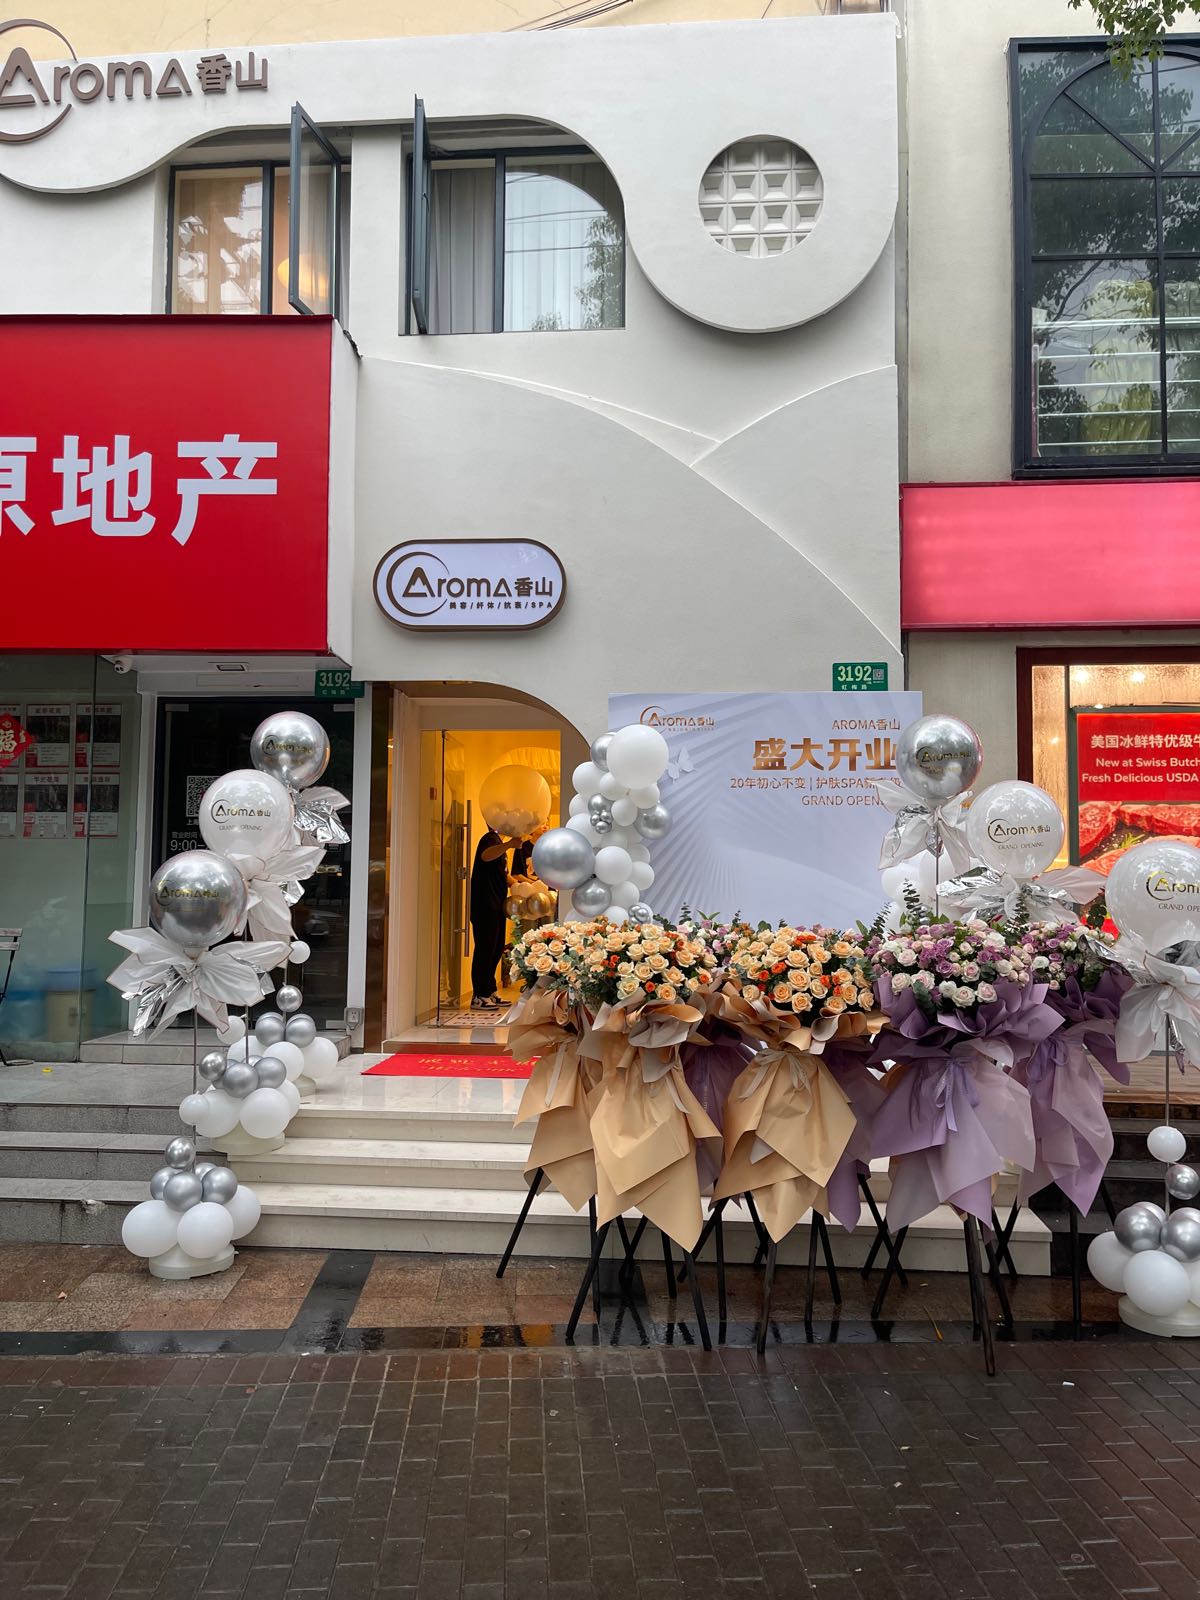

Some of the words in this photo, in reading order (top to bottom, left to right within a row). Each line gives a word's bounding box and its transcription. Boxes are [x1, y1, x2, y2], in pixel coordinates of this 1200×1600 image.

[319, 671, 351, 687] 3192
[837, 665, 872, 682] 3192
[752, 737, 898, 772] 盛大开业
[1095, 758, 1120, 768] New
[1122, 759, 1134, 768] at
[1136, 758, 1168, 768] Swiss
[1170, 758, 1200, 768] Butch
[730, 777, 806, 790] 20年初心不变
[816, 777, 904, 790] 护肤SPA新级
[1082, 773, 1111, 783] Fresh
[1114, 773, 1164, 783] Delicious
[1166, 773, 1200, 783] USDA
[801, 795, 844, 806] GRAND
[846, 795, 884, 806] OPEN
[1158, 903, 1184, 911] GRAND
